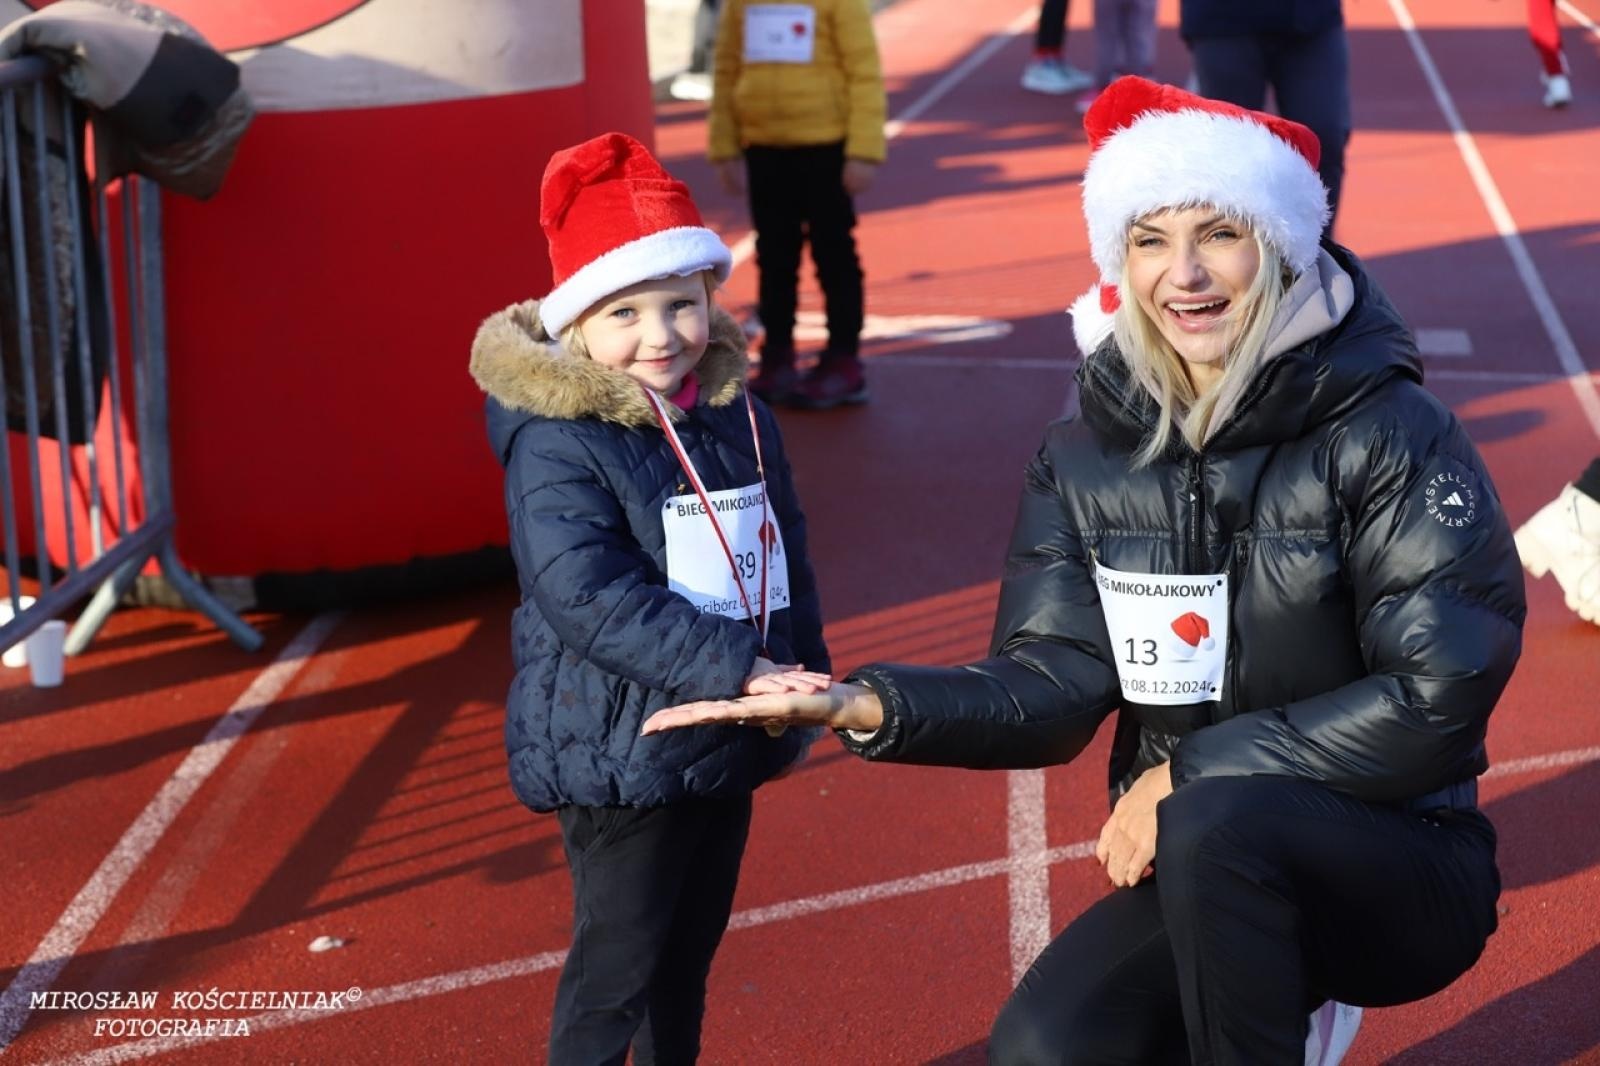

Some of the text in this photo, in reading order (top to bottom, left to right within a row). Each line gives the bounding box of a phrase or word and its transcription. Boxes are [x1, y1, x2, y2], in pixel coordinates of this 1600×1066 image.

[677, 503, 706, 517] BIEG
[733, 551, 756, 580] 39
[1110, 580, 1216, 597] MIKOŁAJKOWY
[695, 597, 737, 614] acibórz
[1125, 638, 1158, 666] 13
